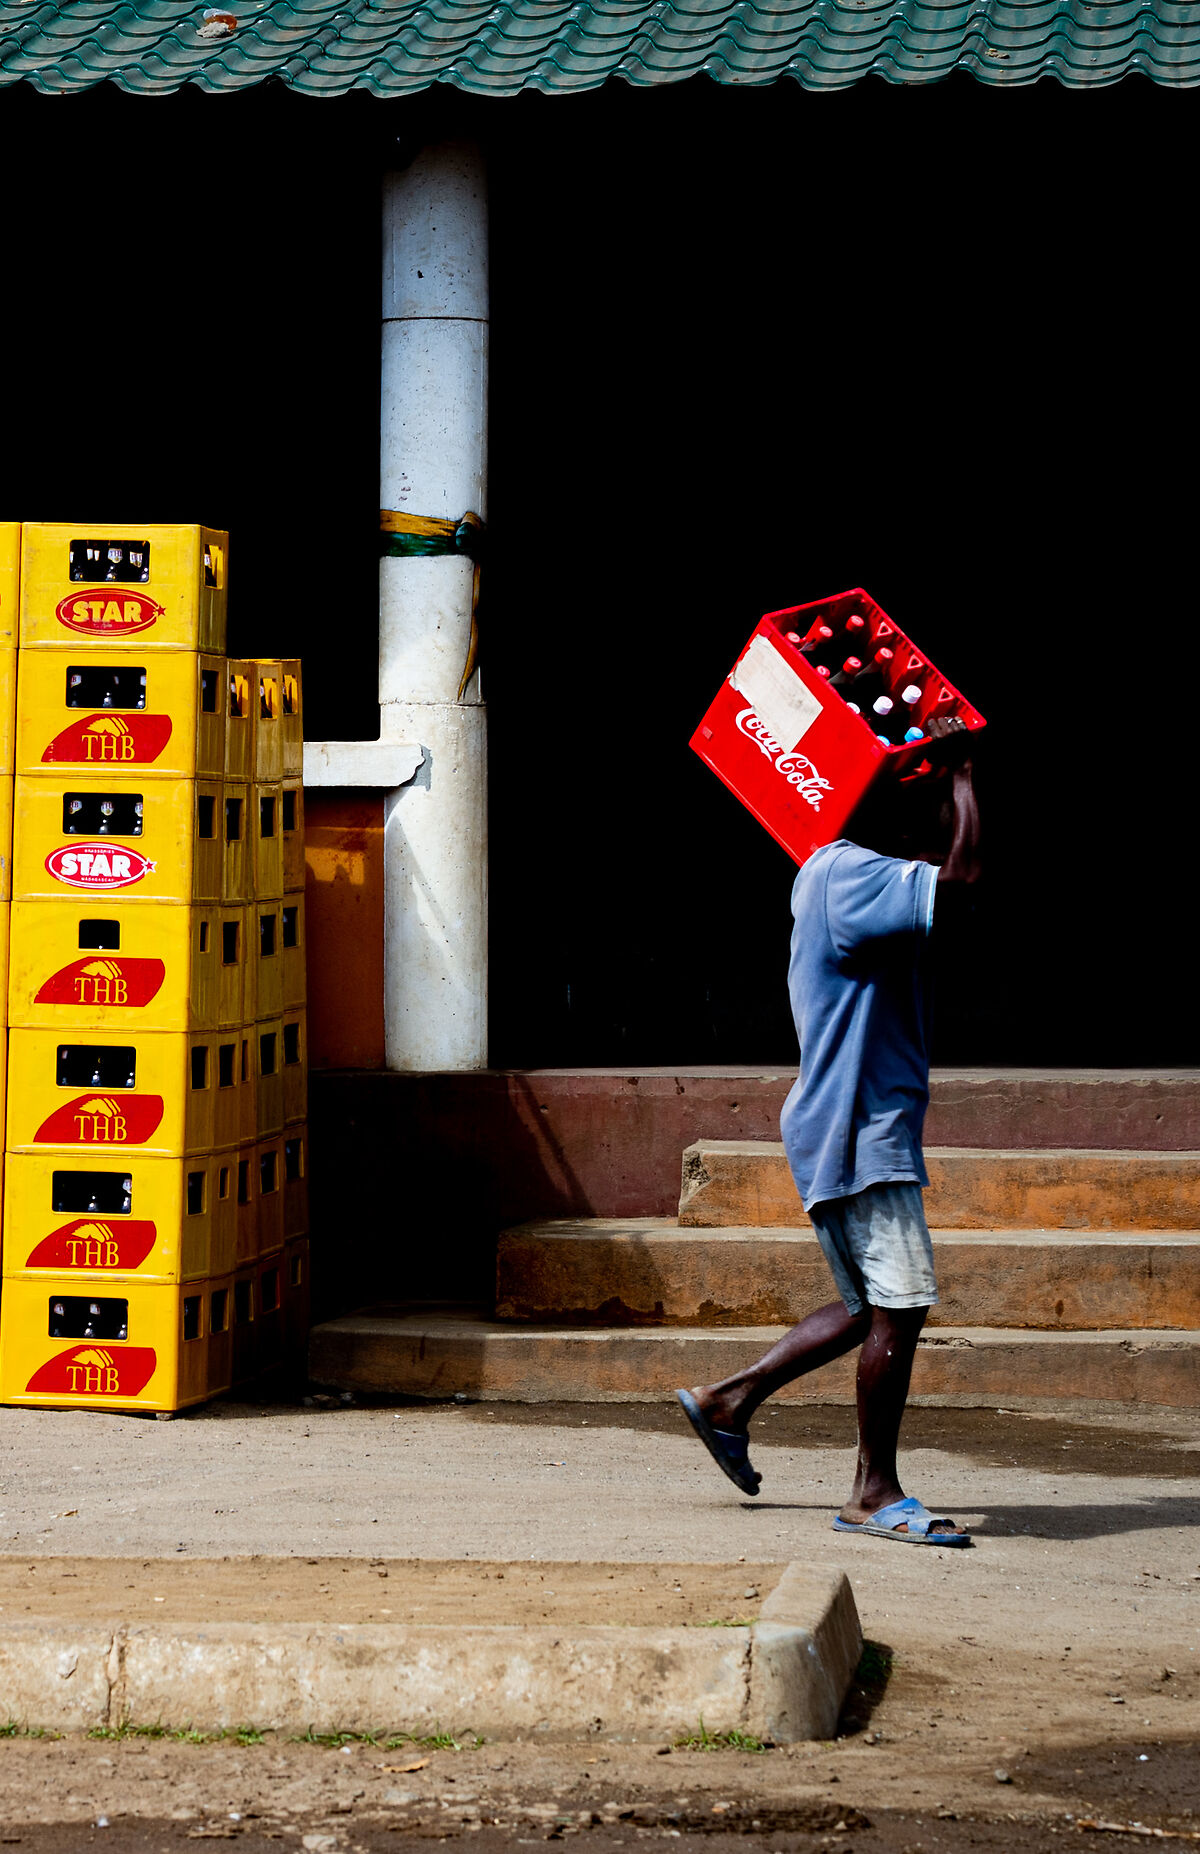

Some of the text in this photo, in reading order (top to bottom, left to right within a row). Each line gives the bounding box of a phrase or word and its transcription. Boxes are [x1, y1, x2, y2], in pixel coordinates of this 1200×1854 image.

[72, 600, 143, 622] STAR
[81, 734, 135, 760] THB
[60, 853, 131, 877] STAR
[75, 977, 128, 1004] THB
[74, 1115, 127, 1141] THB
[66, 1240, 119, 1266] THB
[66, 1366, 120, 1393] THB
